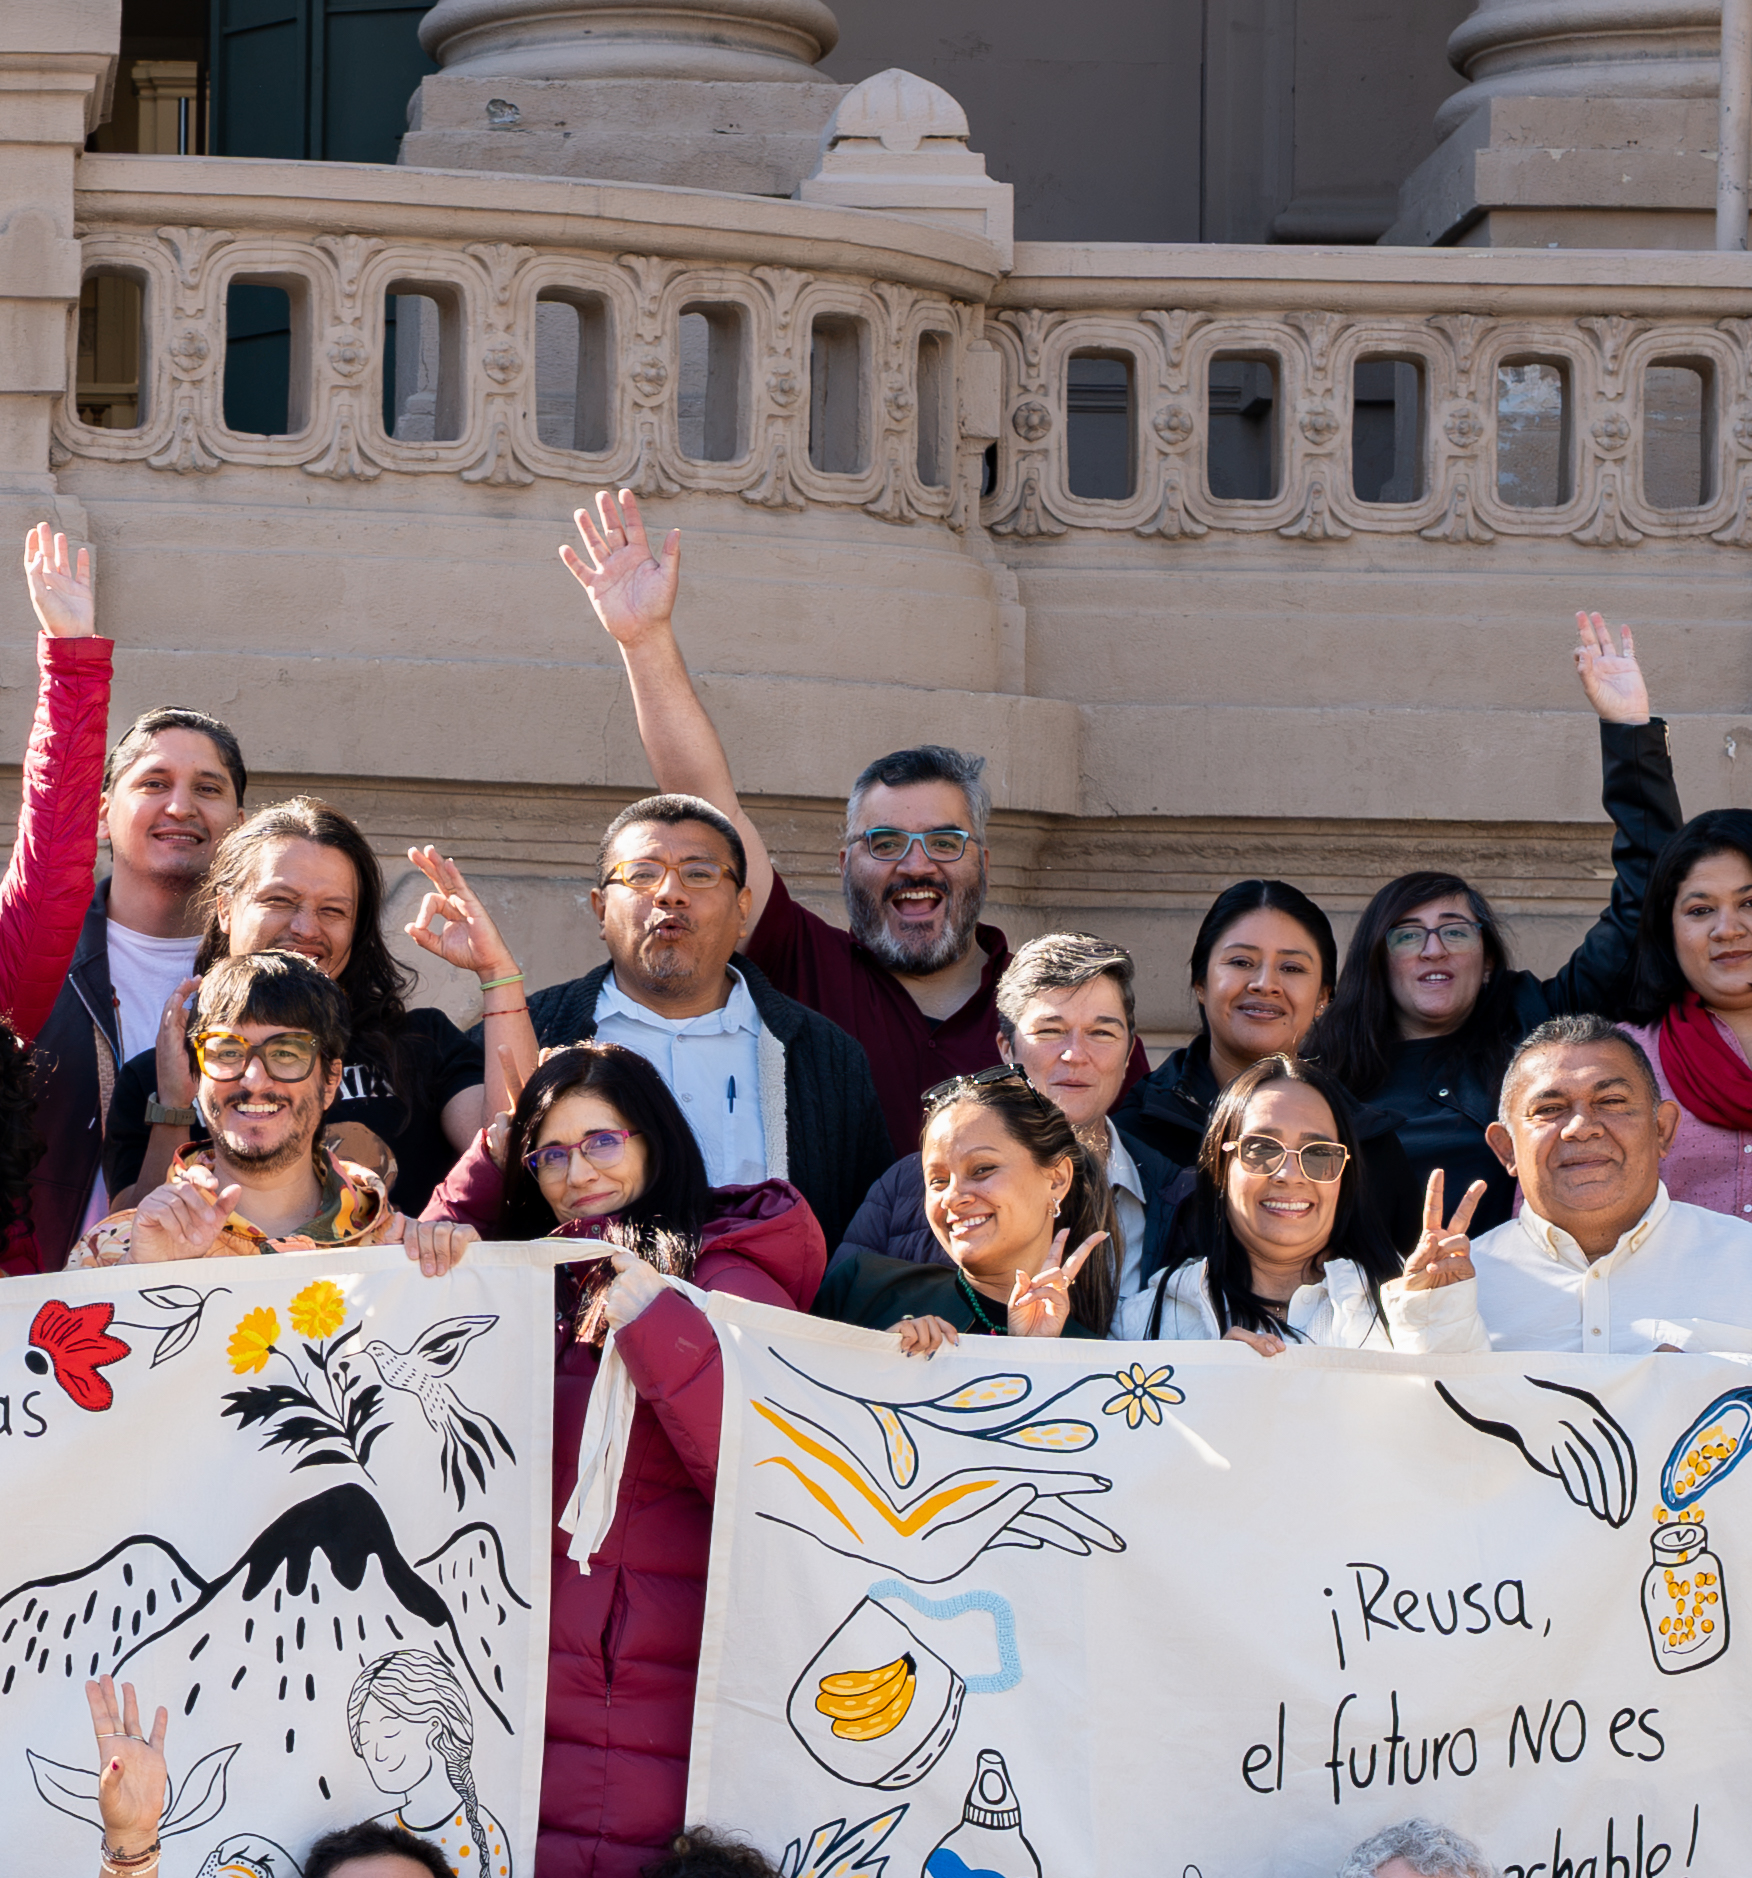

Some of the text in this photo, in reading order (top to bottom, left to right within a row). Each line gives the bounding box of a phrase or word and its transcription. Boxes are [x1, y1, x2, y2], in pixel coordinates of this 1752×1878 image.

[1322, 1562, 1552, 1670] ¡Reusa,
[1241, 1690, 1665, 1805] el futuro NO es
